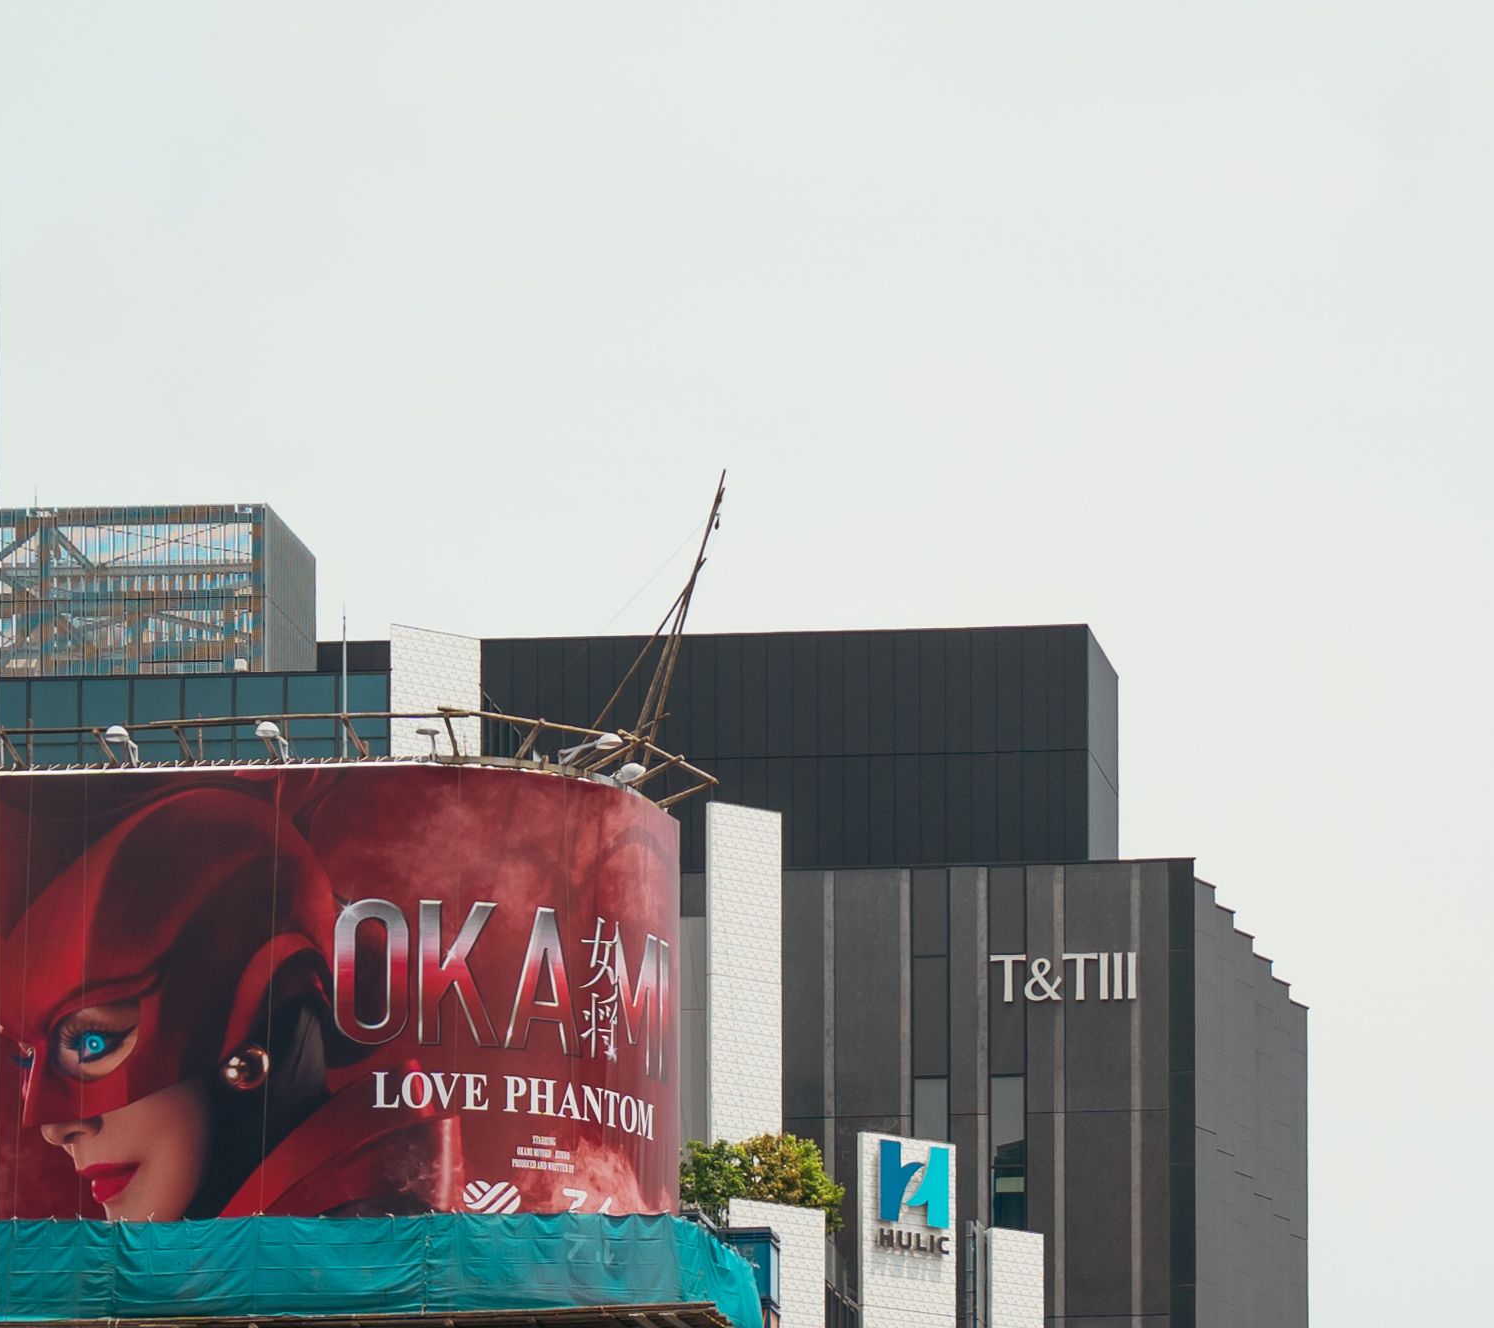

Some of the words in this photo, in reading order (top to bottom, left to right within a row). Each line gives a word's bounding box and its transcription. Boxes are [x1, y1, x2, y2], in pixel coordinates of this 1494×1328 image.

[372, 1071, 489, 1112] LOVE
[502, 1075, 654, 1141] PHANTOM
[878, 1229, 950, 1255] HULIC
